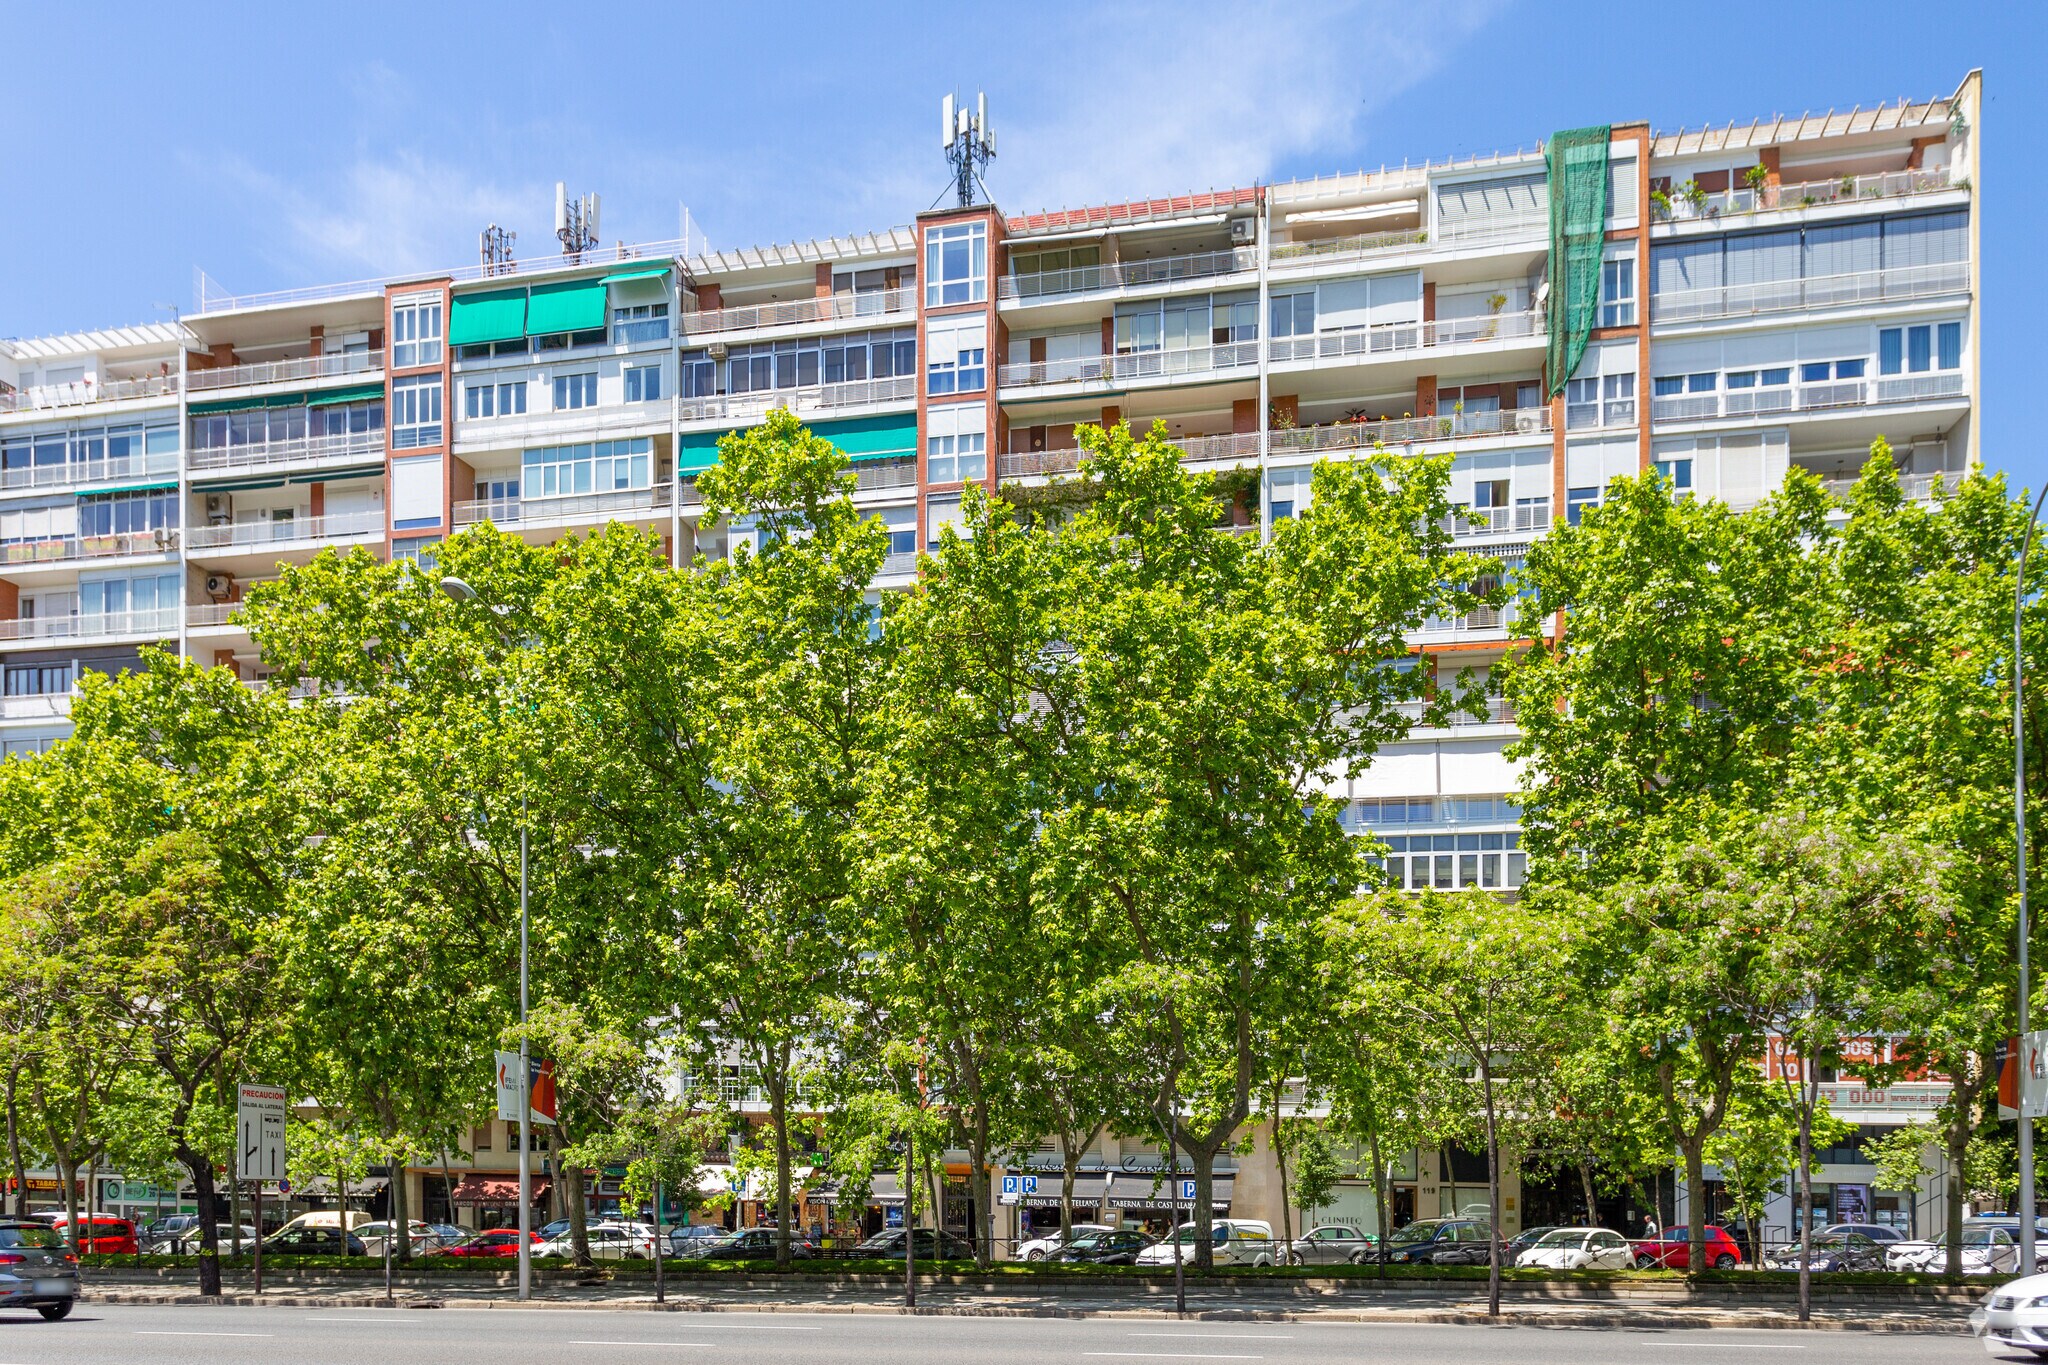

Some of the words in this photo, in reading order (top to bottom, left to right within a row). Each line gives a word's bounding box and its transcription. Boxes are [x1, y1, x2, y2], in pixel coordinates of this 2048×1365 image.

[265, 1130, 282, 1139] TAXI
[1006, 1178, 1014, 1192] P
[1025, 1178, 1033, 1192] P
[1187, 1183, 1195, 1197] P
[1422, 1187, 1436, 1195] 119
[1049, 1199, 1058, 1207] DE
[1112, 1199, 1141, 1208] TABERNA
[1145, 1200, 1155, 1208] DE
[1321, 1216, 1362, 1225] CLINITEQ
